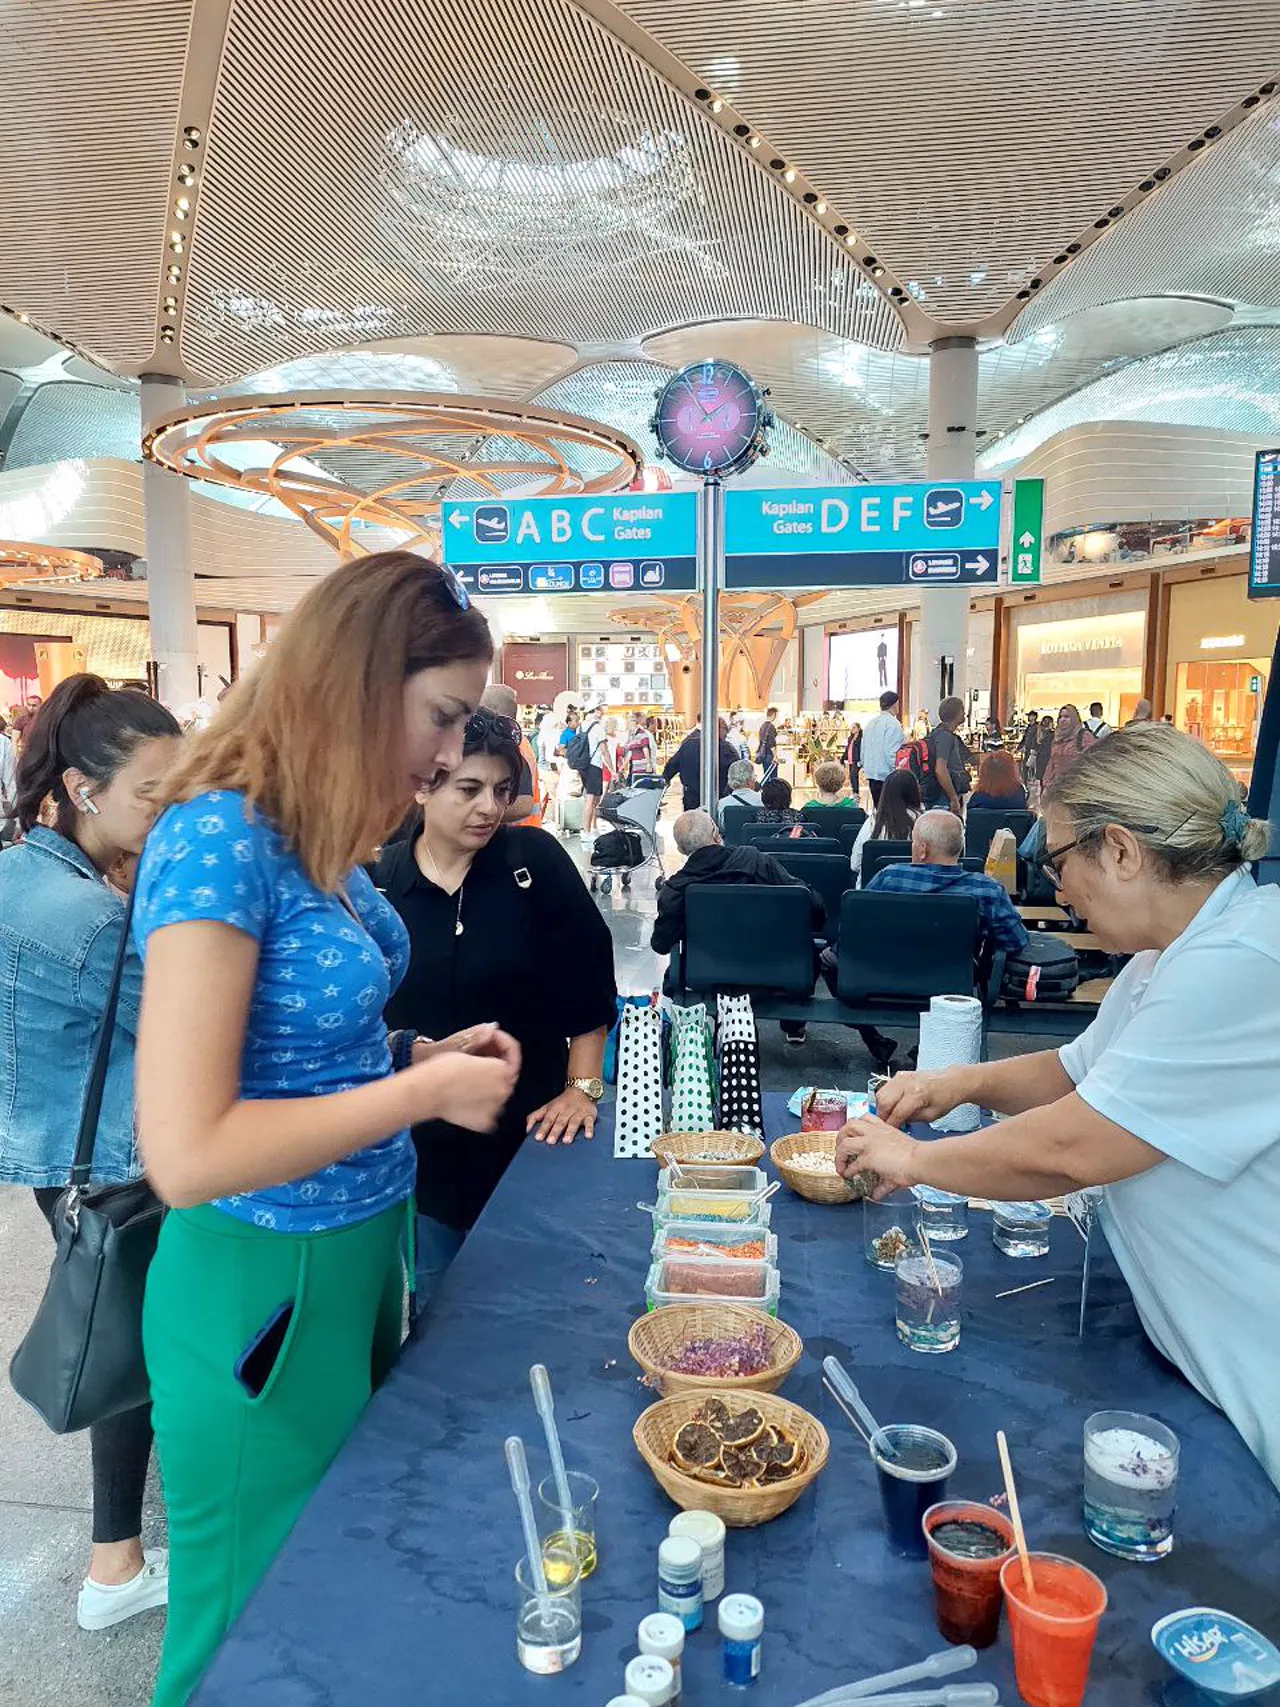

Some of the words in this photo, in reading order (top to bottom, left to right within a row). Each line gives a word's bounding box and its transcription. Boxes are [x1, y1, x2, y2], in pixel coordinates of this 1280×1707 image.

[703, 365, 714, 385] 12
[703, 450, 712, 469] 6
[820, 498, 849, 533] D
[860, 497, 881, 532] E
[892, 496, 914, 531] F
[515, 511, 541, 544] A
[551, 509, 573, 543] B
[581, 507, 606, 541] C
[614, 526, 652, 540] Gates
[773, 519, 813, 534] Gates
